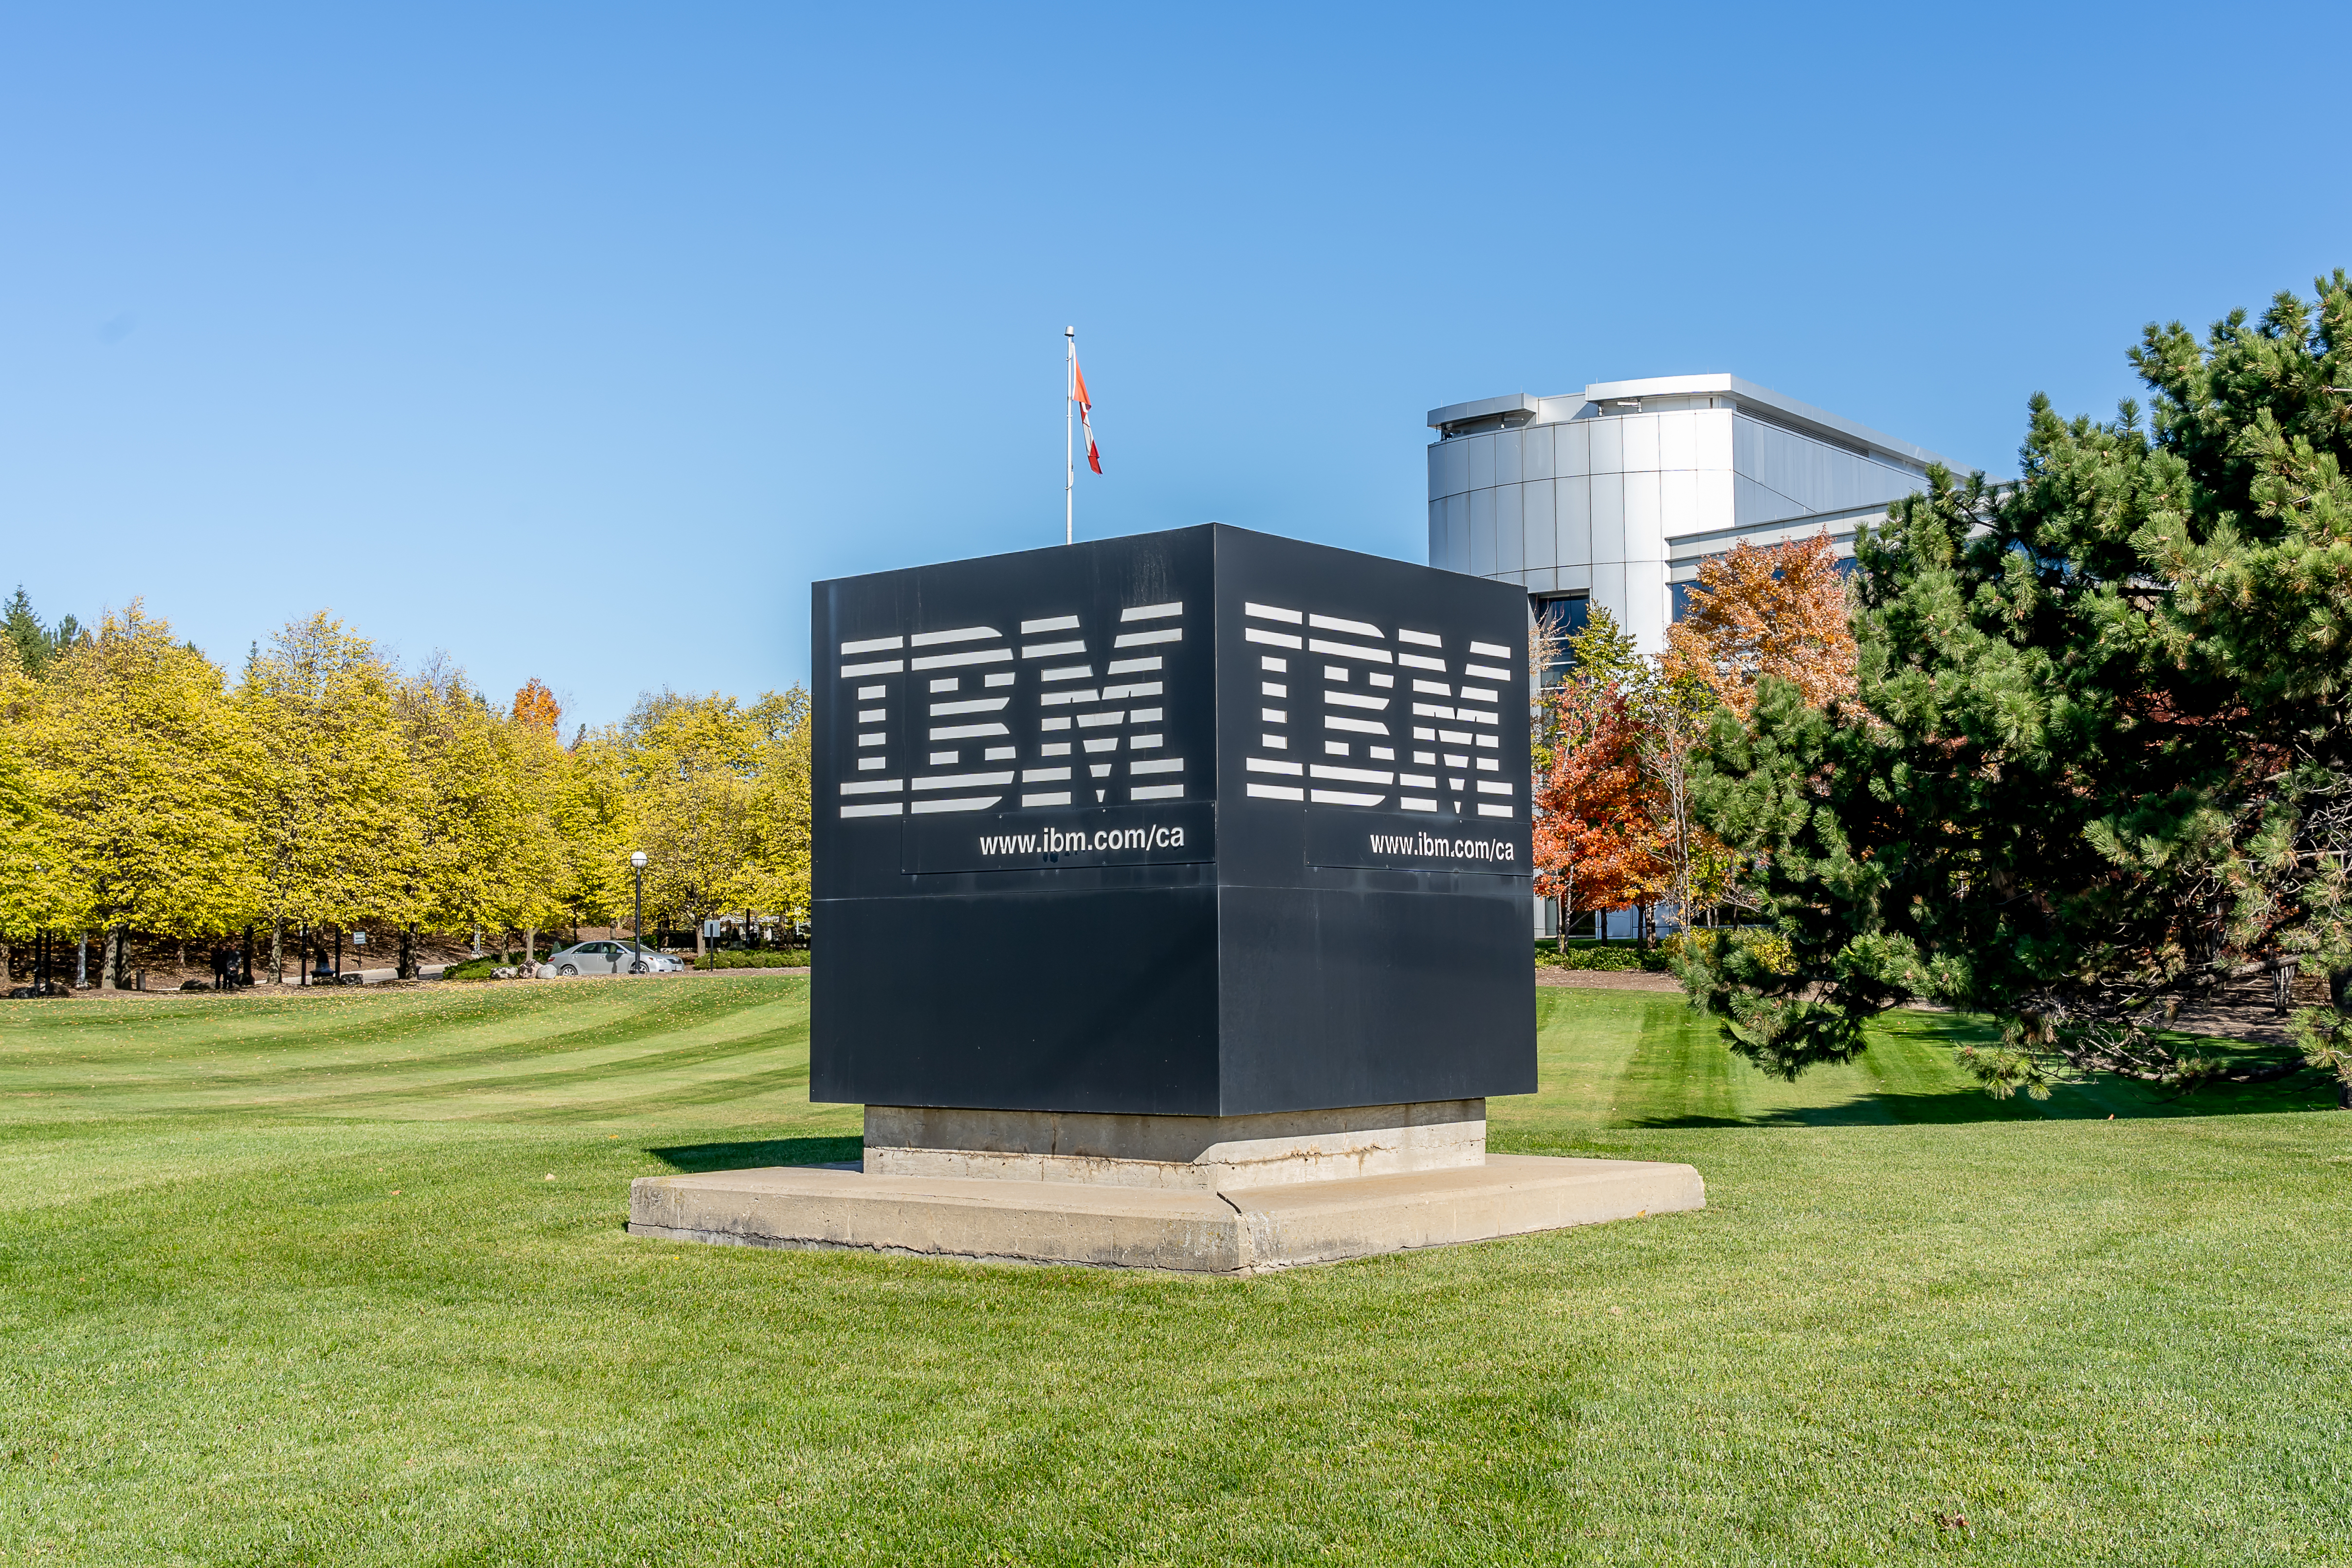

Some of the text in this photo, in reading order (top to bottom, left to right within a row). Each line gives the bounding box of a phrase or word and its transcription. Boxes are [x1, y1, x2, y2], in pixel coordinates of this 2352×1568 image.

[840, 601, 1184, 819] IBM
[1245, 601, 1513, 818] IBM
[979, 824, 1185, 855] www.ibm.com/ca
[1370, 831, 1515, 862] www.ibm.com/ca
